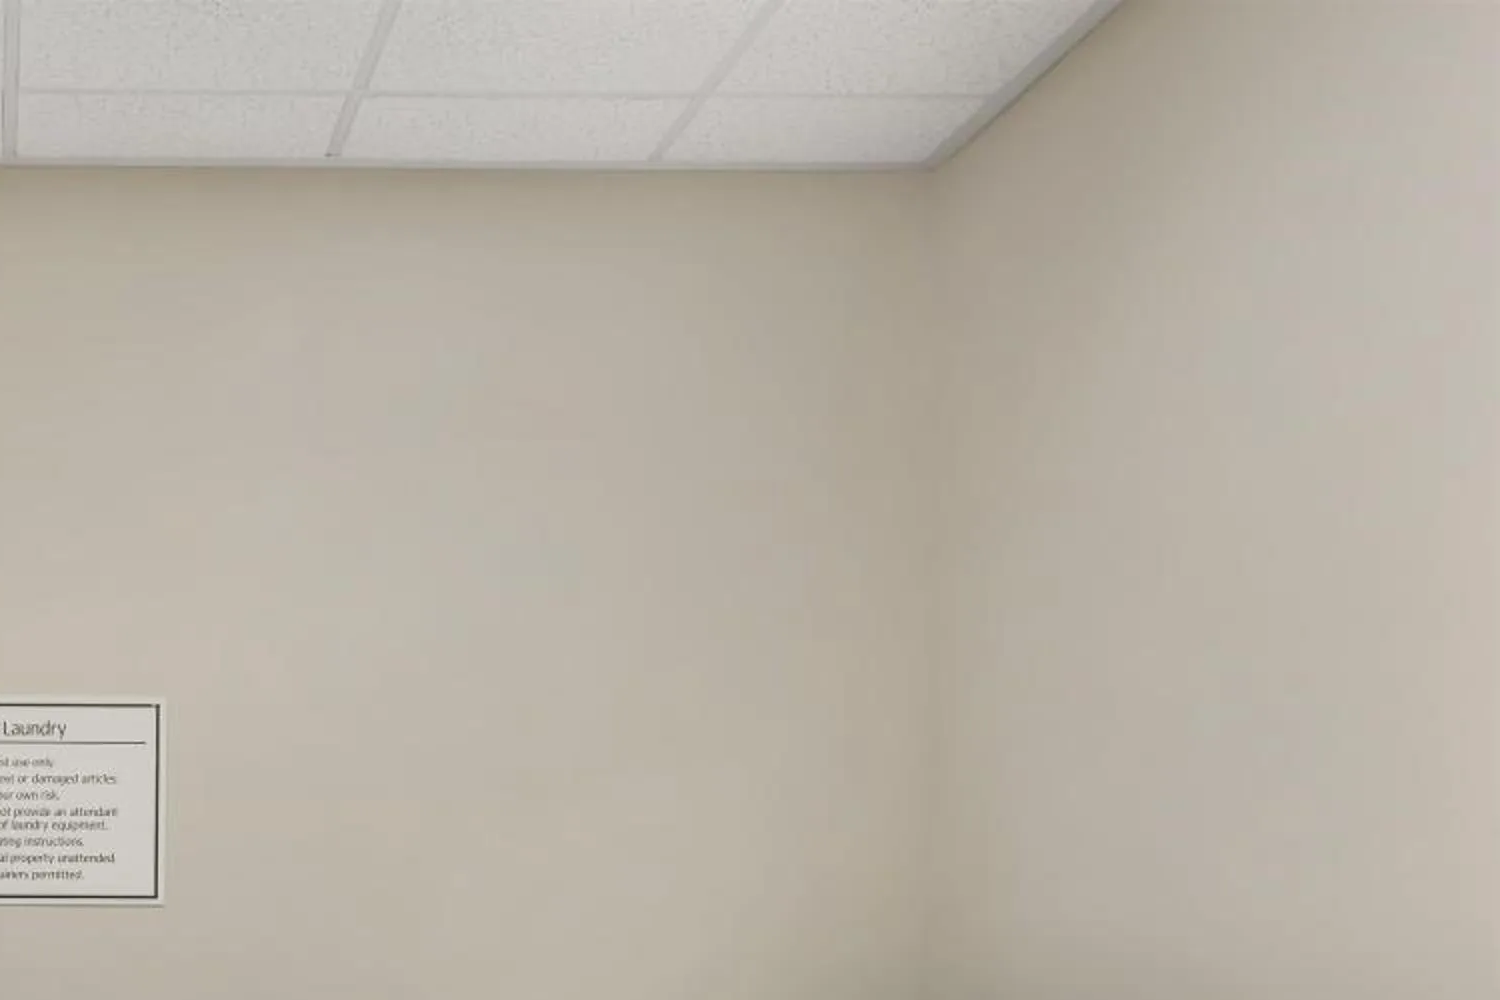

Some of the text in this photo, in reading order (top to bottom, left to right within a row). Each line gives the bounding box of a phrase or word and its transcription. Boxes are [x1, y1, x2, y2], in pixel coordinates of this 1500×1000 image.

[3, 720, 67, 739] Laundry
[17, 775, 30, 784] or
[31, 774, 78, 787] damaged
[15, 792, 38, 801] own
[14, 807, 51, 819] provide
[54, 809, 66, 817] an
[69, 807, 118, 818] attendant
[11, 820, 48, 832] laundry
[10, 853, 56, 865] property
